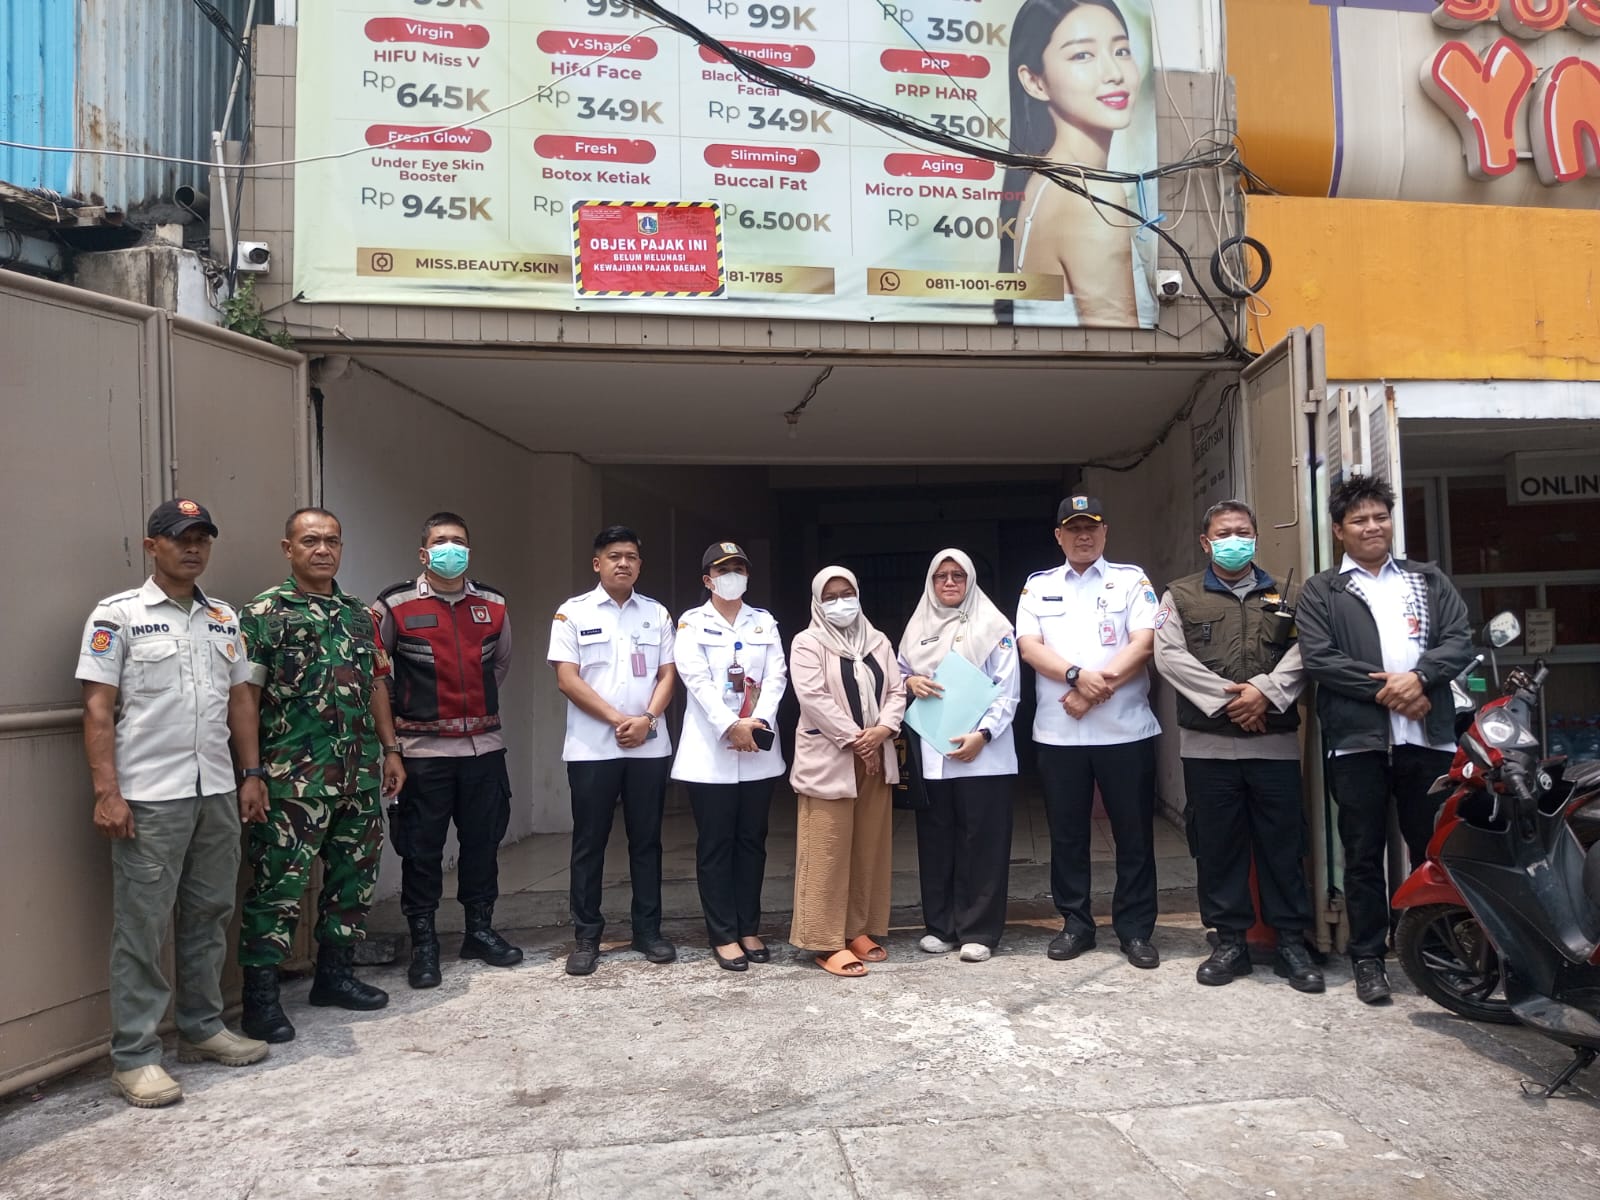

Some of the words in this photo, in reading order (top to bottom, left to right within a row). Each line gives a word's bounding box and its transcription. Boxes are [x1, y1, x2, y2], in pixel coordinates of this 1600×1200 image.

[747, 4, 818, 31] 99K
[883, 4, 914, 25] Rp
[927, 17, 1008, 47] 350K
[405, 23, 454, 41] Virgin
[568, 38, 632, 55] V-Shape
[373, 50, 417, 64] HIFU
[422, 52, 462, 67] Miss
[467, 56, 480, 69] V
[921, 58, 950, 70] PRP
[551, 62, 591, 77] Hifu
[597, 65, 642, 80] Face
[702, 70, 742, 82] Black
[363, 70, 396, 91] Rp
[396, 83, 491, 113] 645K
[895, 84, 930, 98] PRP
[936, 87, 977, 101] HAIR
[537, 85, 570, 108] Rp
[577, 96, 664, 125] 349K
[709, 101, 741, 123] Rp
[747, 105, 834, 134] 349K
[930, 113, 1008, 140] 350K
[388, 131, 430, 144] Fresh
[433, 132, 472, 145] Glow
[575, 142, 618, 155] Fresh
[730, 149, 797, 166] Slimming
[371, 157, 417, 170] Under
[421, 159, 449, 173] Eye
[452, 159, 485, 172] Skin
[921, 159, 964, 175] Aging
[399, 170, 457, 184] Booster
[541, 167, 592, 183] Botox
[596, 170, 651, 185] Ketiak
[714, 173, 775, 189] Buccal
[780, 176, 808, 191] Fat
[865, 182, 914, 198] Micro
[919, 185, 957, 199] DNA
[961, 186, 1027, 202] Salmon
[361, 187, 395, 210] Rp
[401, 193, 493, 222] 945K
[533, 195, 564, 217] Rp
[739, 209, 832, 233] 6.500K
[888, 208, 919, 231] Rp
[933, 215, 1017, 240] 400K
[590, 238, 637, 250] OBJEK
[640, 238, 684, 251] PAJAK
[688, 239, 708, 251] INI
[416, 257, 559, 275] MISS.BEAUTY.SKIN
[613, 253, 642, 261] BELUM
[644, 253, 686, 262] MELUNASI
[593, 263, 643, 272] KEWAJIBAN
[645, 264, 672, 272] PAJAK
[673, 264, 707, 273] DAERAH
[925, 278, 1027, 292] 0811-1001-6719
[131, 623, 170, 637] INDRO
[208, 623, 226, 635] POL
